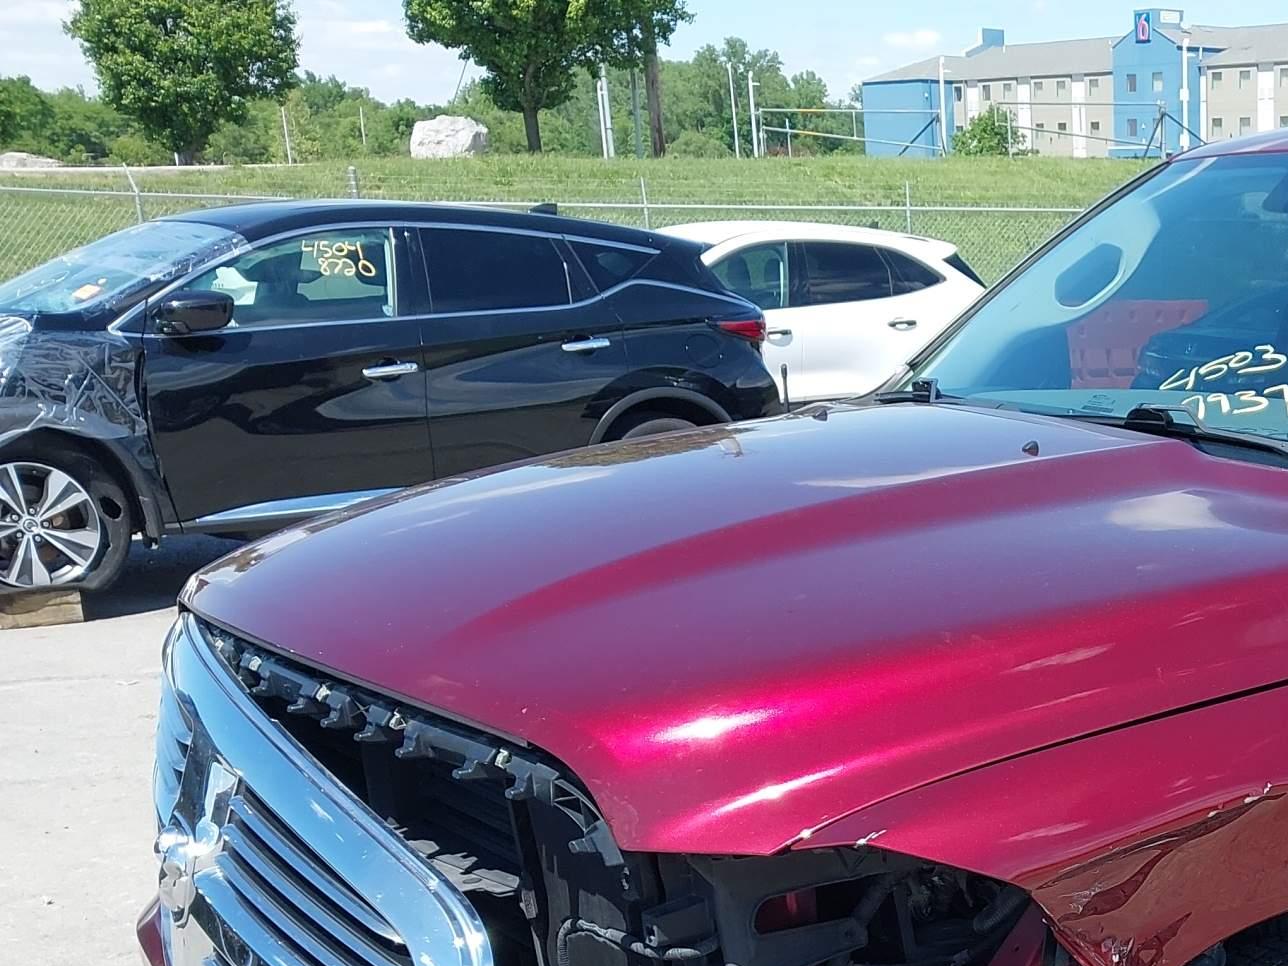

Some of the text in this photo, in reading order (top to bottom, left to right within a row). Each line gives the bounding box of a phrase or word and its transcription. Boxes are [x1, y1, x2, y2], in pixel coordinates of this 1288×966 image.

[301, 239, 364, 260] 4504
[318, 257, 376, 277] 8720
[1158, 343, 1288, 391] 4503
